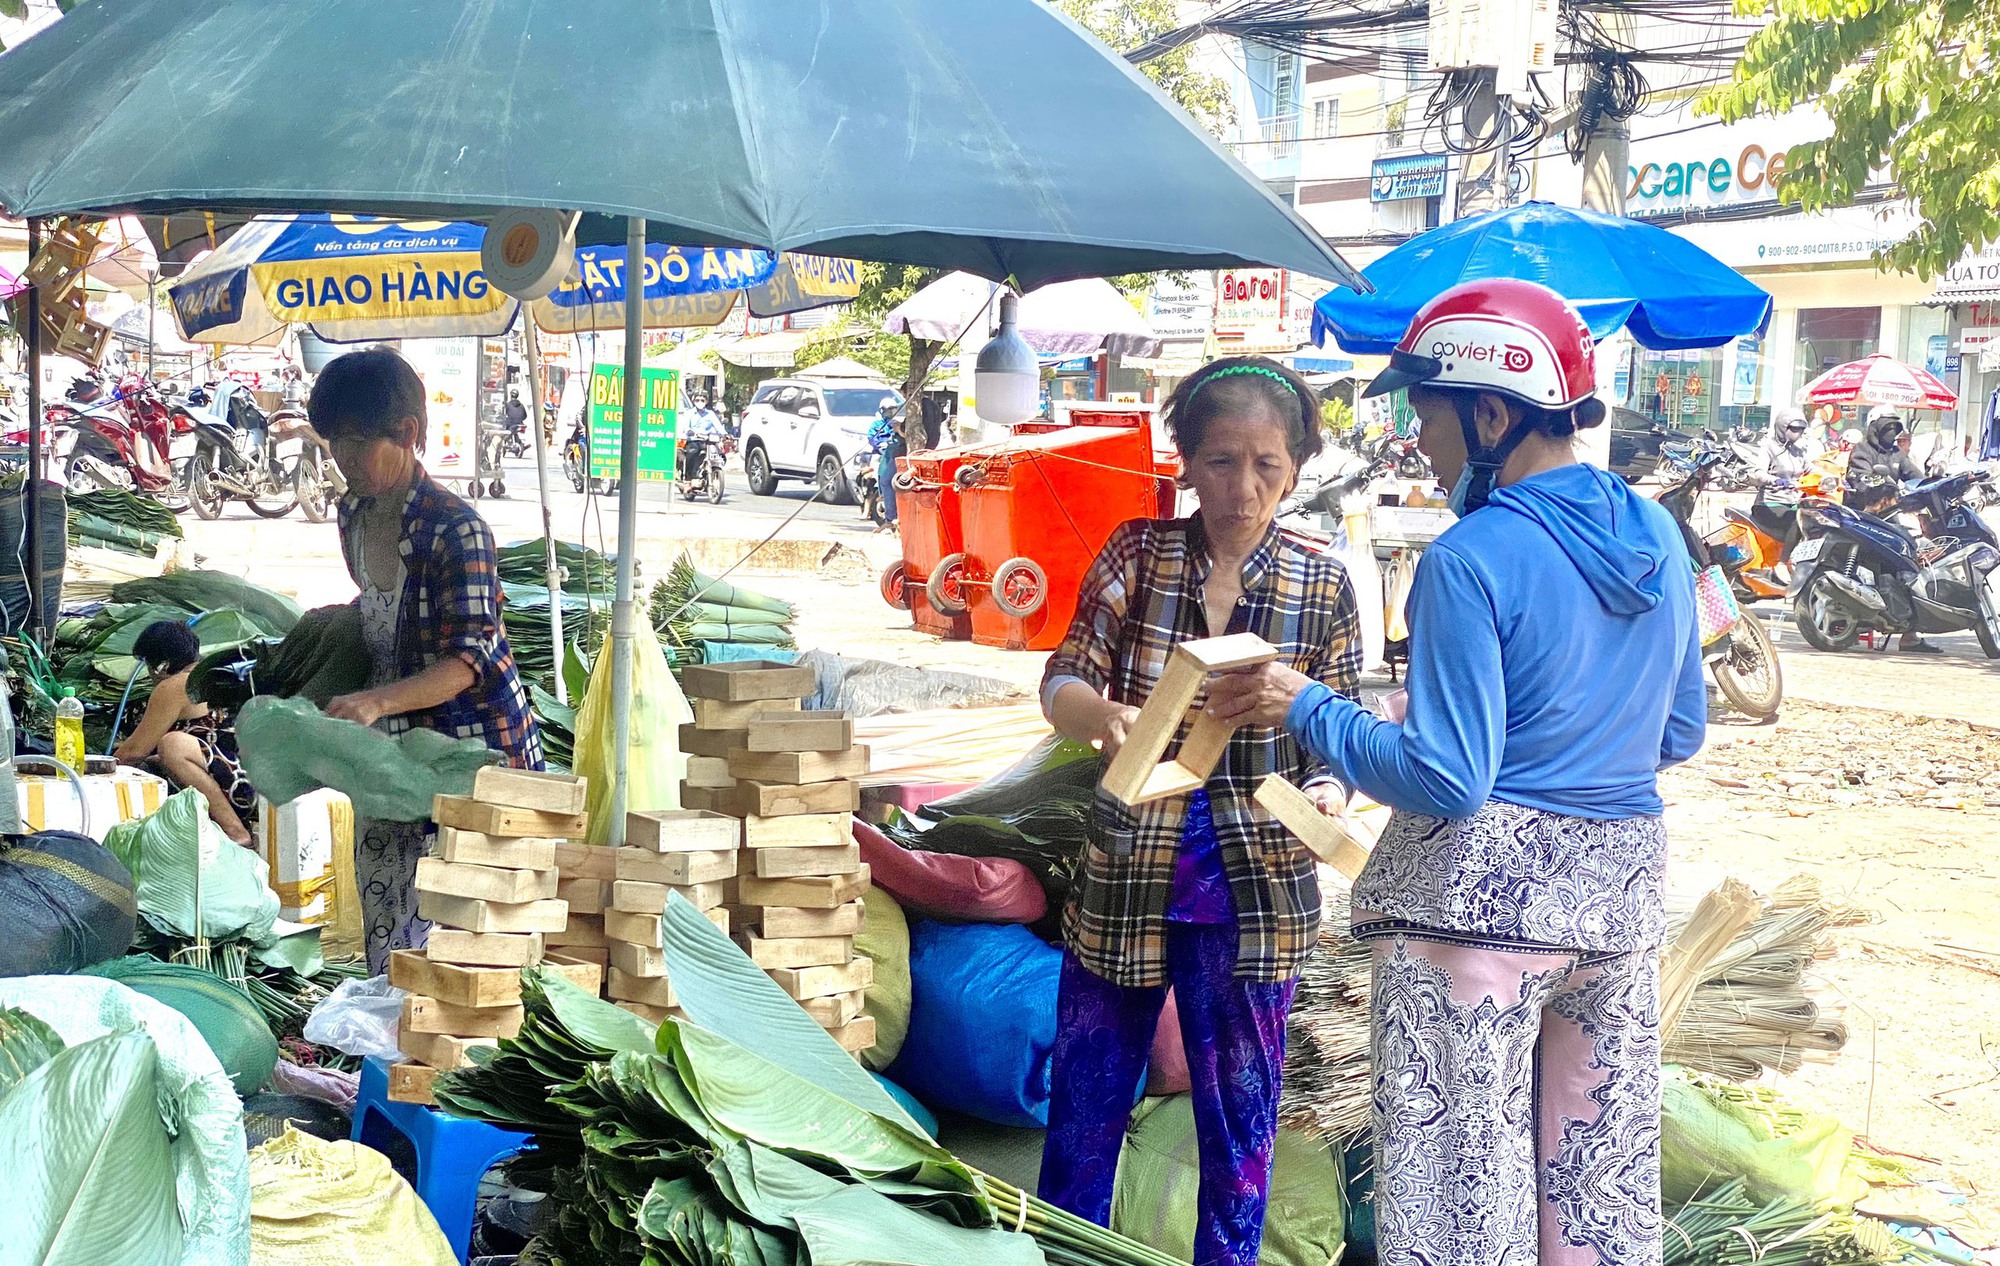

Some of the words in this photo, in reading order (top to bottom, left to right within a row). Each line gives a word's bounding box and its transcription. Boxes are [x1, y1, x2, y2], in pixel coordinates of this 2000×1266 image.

[346, 239, 378, 252] tảng
[383, 238, 402, 249] đa
[405, 237, 438, 249] dịch
[441, 237, 458, 249] vụ
[1769, 247, 1781, 256] 900
[1786, 246, 1799, 255] 902
[1803, 245, 1816, 254] 904
[829, 257, 856, 285] BAY
[276, 274, 373, 309] GIAO
[381, 261, 489, 303] HÀNG
[1946, 357, 1959, 367] 898
[595, 368, 647, 408] BÁH
[652, 372, 676, 410] MÌ
[604, 411, 642, 424] NG
[647, 412, 665, 425] HÀ
